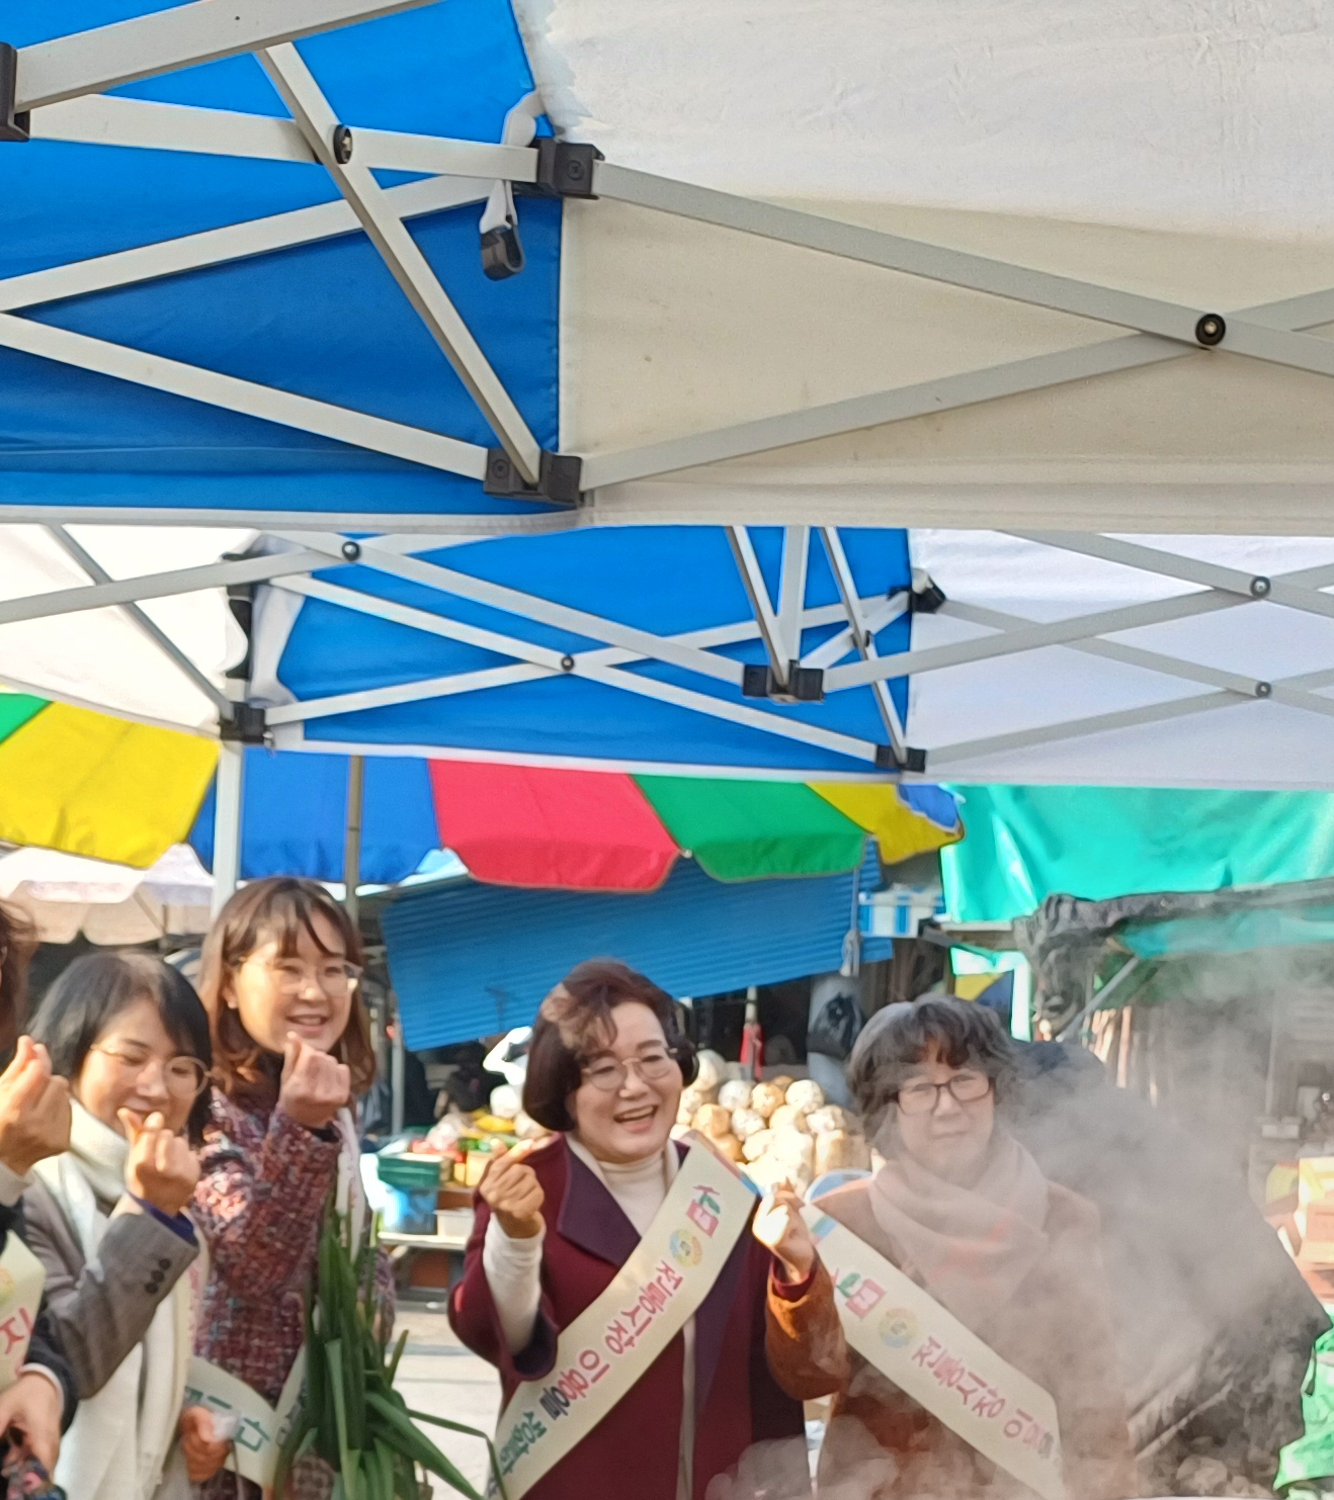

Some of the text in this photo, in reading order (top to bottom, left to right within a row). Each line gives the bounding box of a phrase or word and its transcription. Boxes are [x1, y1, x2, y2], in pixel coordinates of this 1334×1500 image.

[605, 1260, 683, 1355] 전통시장
[539, 1349, 610, 1421] 이용을
[911, 1336, 1006, 1419] 전통시장
